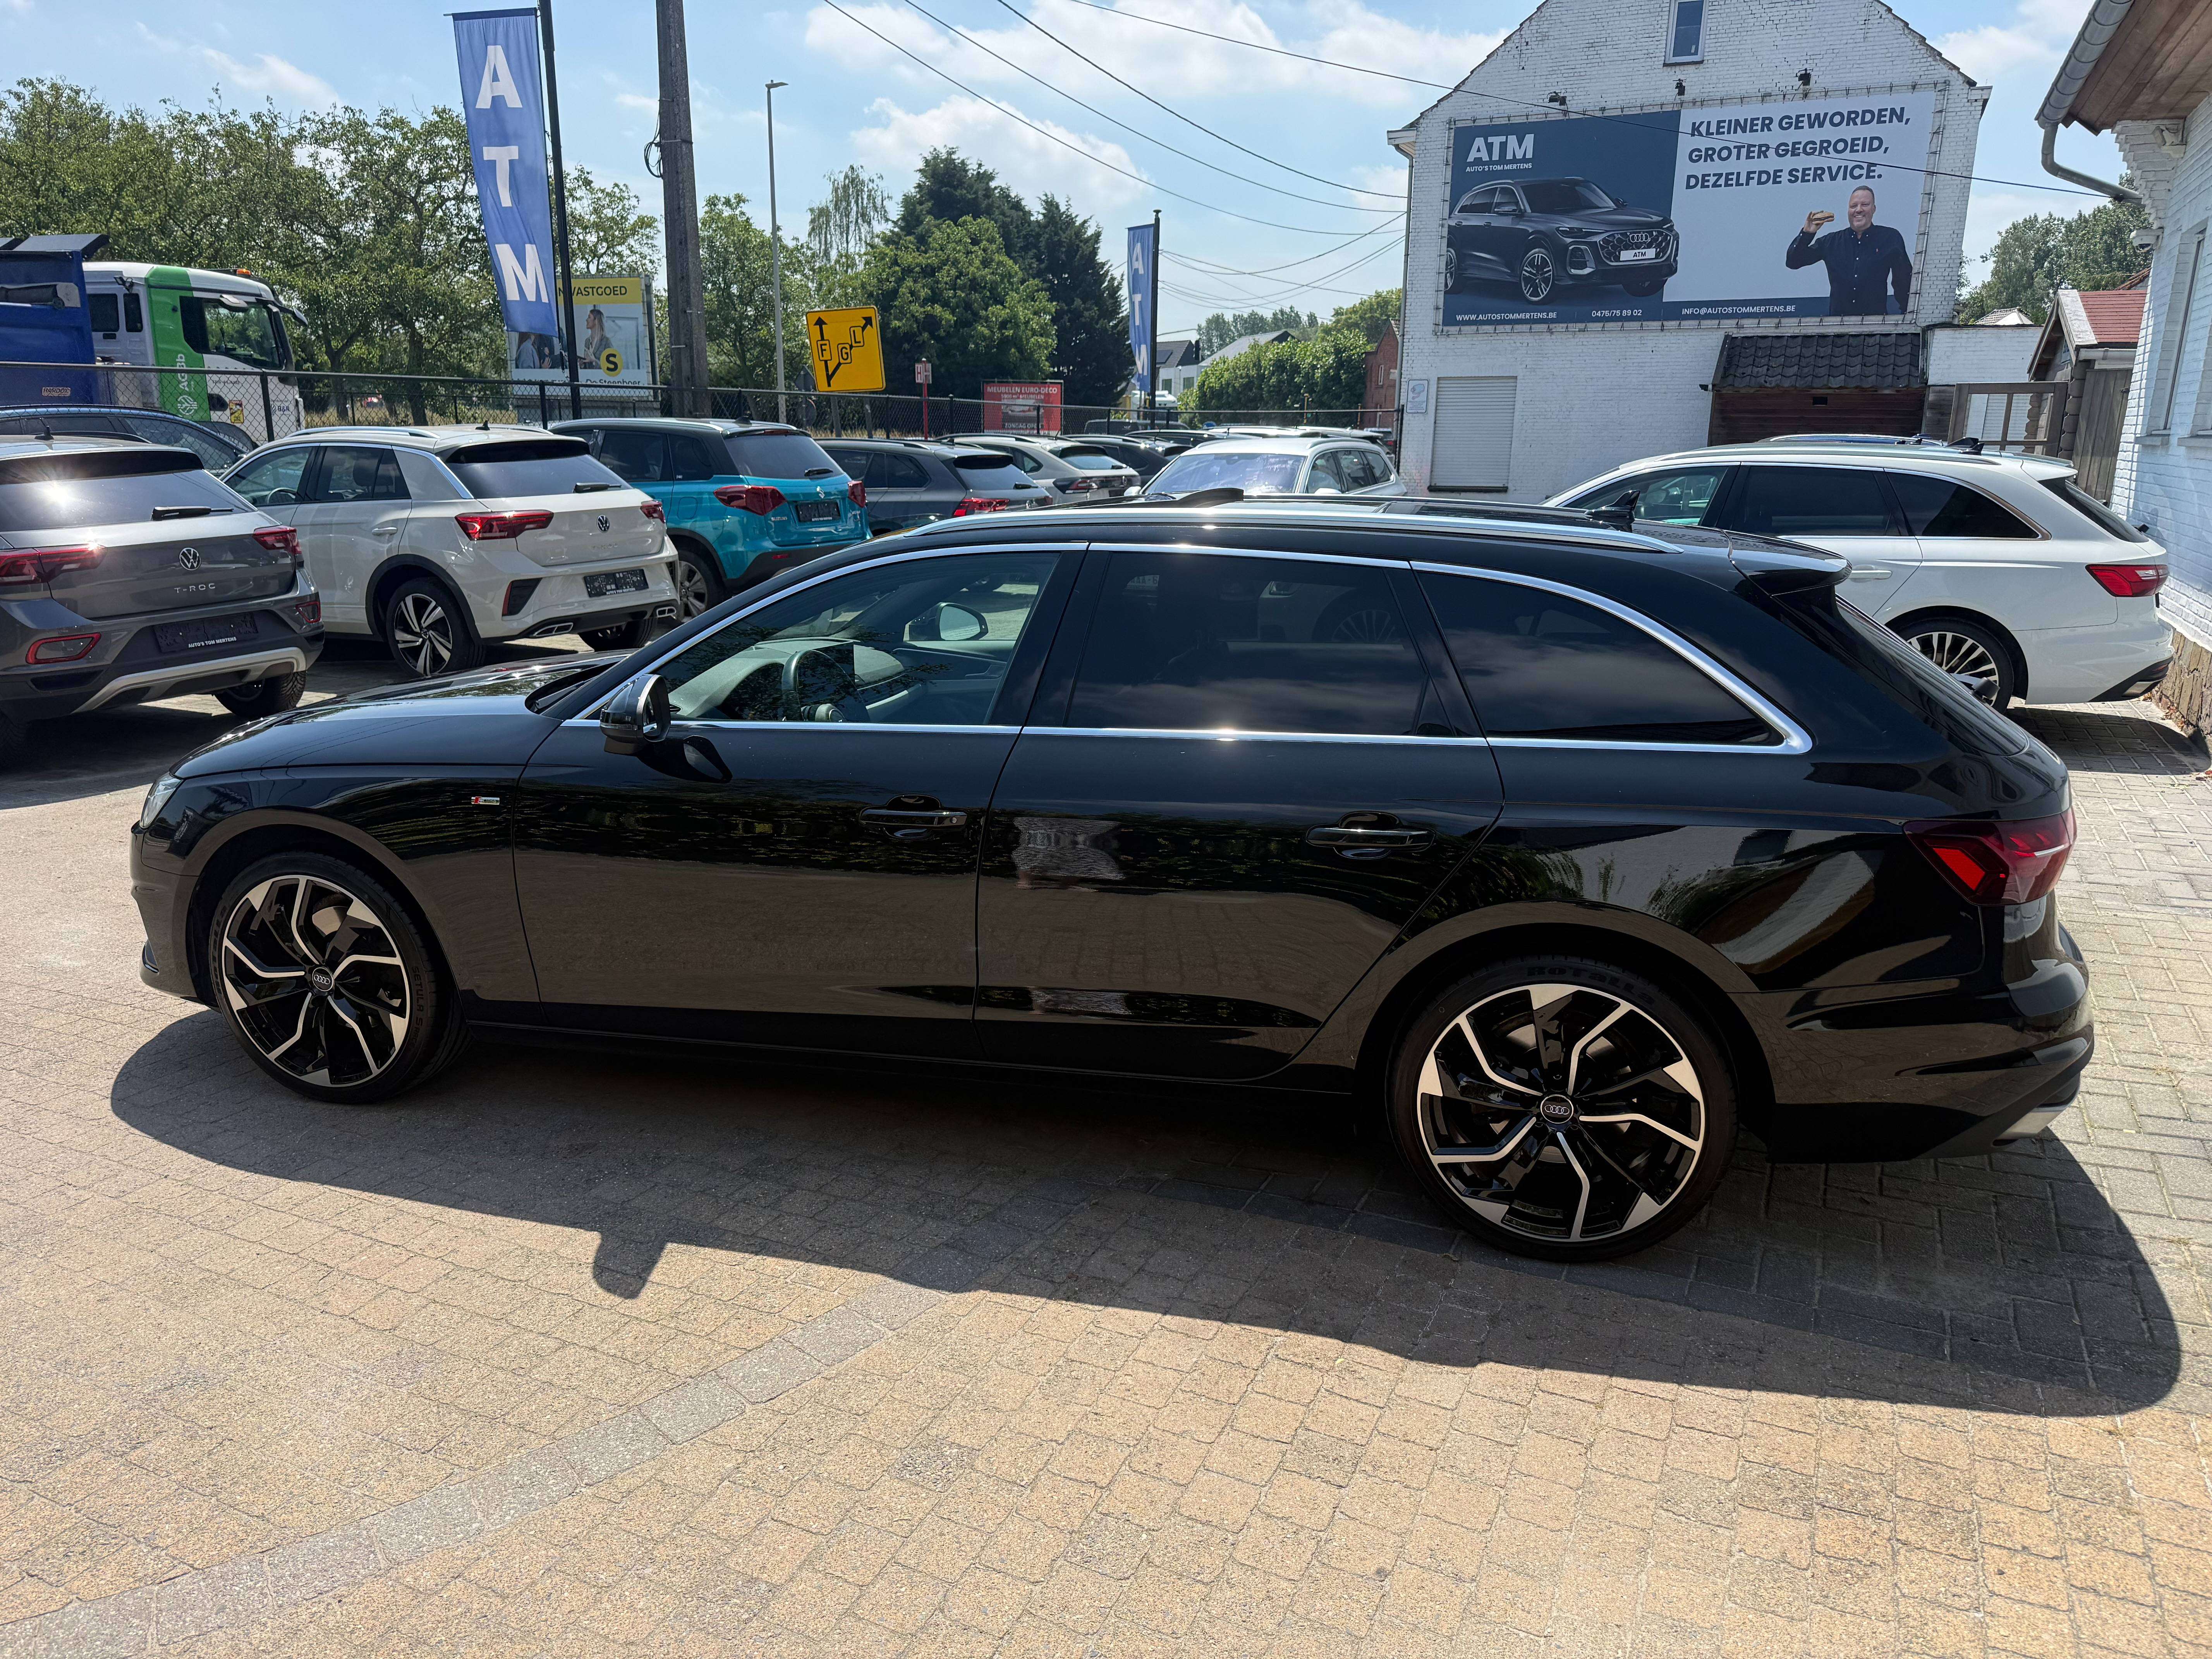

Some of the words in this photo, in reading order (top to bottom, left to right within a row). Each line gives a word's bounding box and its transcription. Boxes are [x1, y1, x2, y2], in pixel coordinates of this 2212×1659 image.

[1691, 116, 1774, 137] KLEINER
[1778, 106, 1911, 131] GEWORDEN,
[1466, 134, 1534, 162] ATM
[1688, 143, 1770, 163] GROTER
[1774, 136, 1889, 158] GEGROEID,
[475, 45, 549, 303] ATM
[1685, 168, 1783, 190] DEZELFDE
[1787, 163, 1883, 184] SERVICE.
[1132, 242, 1147, 376] ATM
[1456, 312, 1557, 321] WWW.AUTOSTOMMERTENS.BE
[1681, 305, 1796, 315] INFO@AUTOSTOMMERTENS.BE
[853, 329, 861, 344] L
[820, 343, 827, 358] F
[840, 347, 849, 361] G
[605, 353, 618, 372] S
[174, 583, 216, 593] T-ROC
